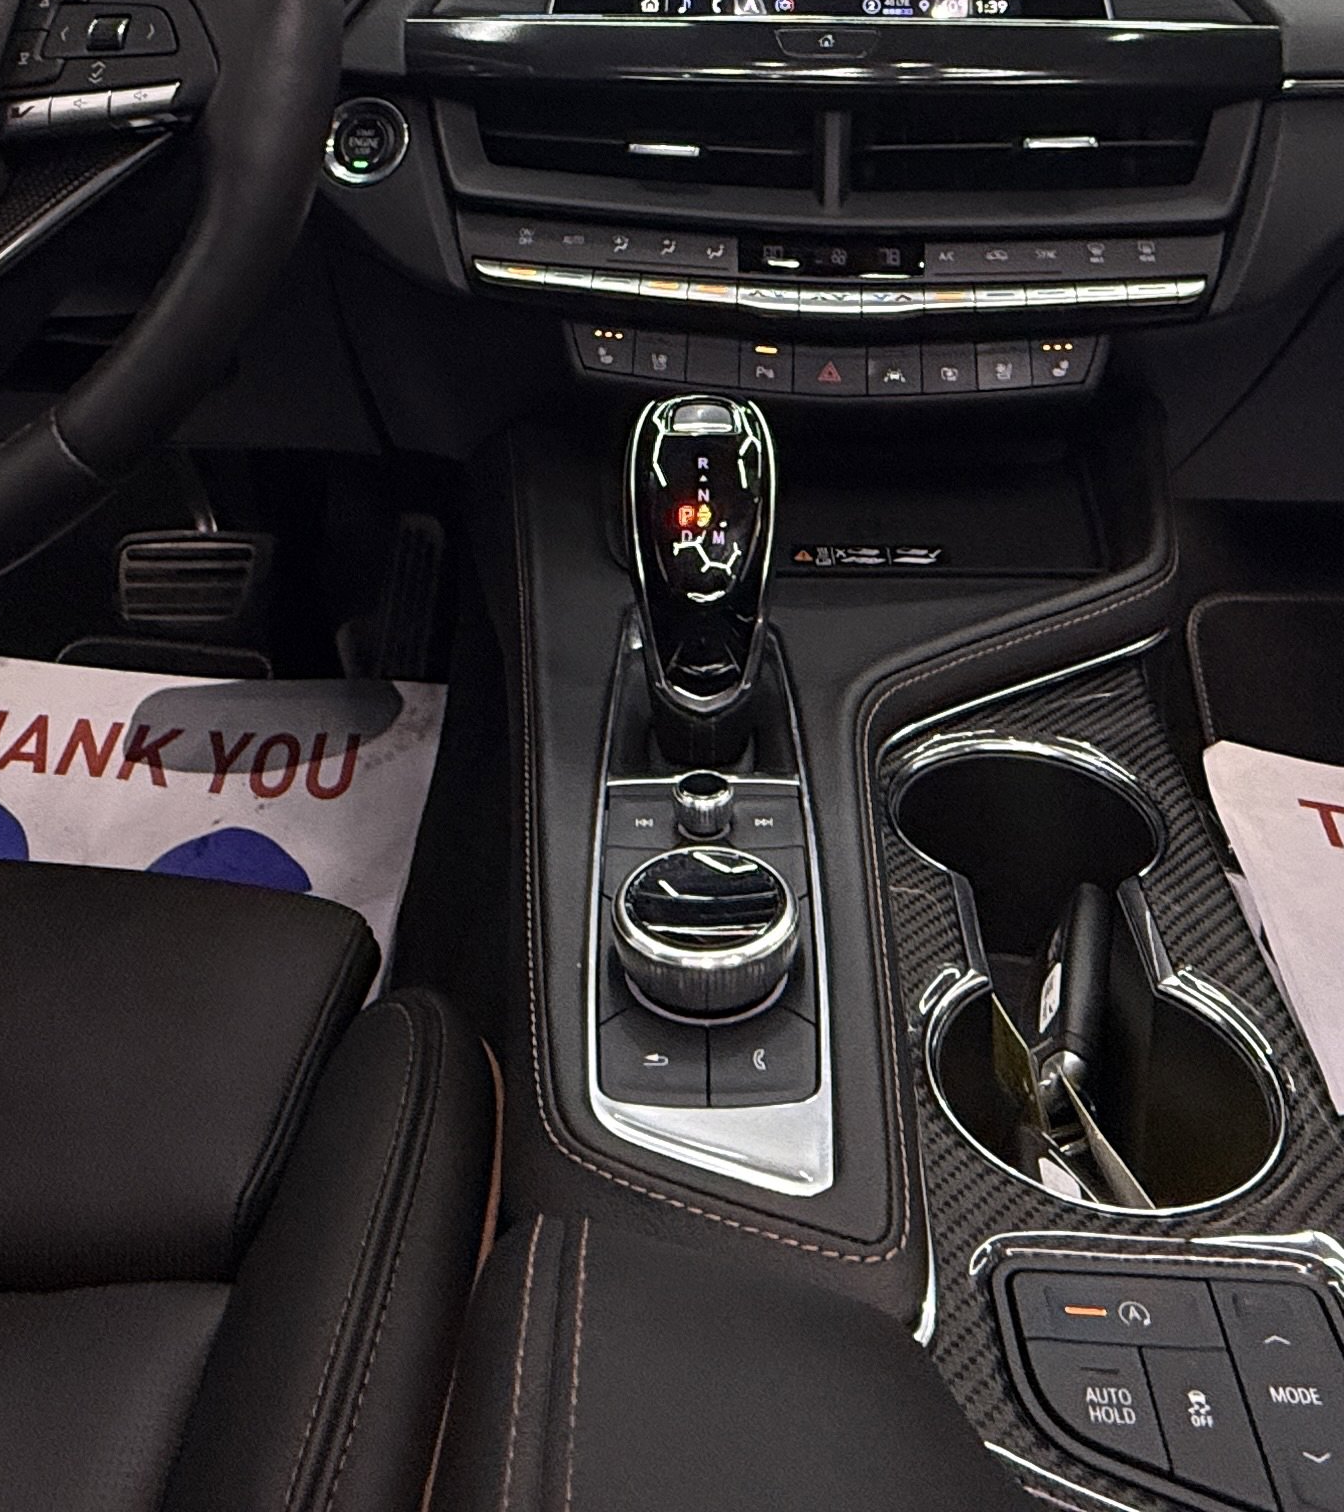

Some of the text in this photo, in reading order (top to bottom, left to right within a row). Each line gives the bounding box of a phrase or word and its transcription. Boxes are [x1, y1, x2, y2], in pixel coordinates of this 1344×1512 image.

[975, 0, 1008, 14] 1:39
[698, 457, 709, 469] R
[697, 488, 710, 502] N
[678, 505, 695, 527] P
[712, 530, 725, 545] M
[207, 730, 361, 801] YOU
[1085, 1386, 1132, 1406] AUTO
[1269, 1386, 1323, 1407] MODE
[1088, 1405, 1137, 1426] HOLD
[1191, 1414, 1215, 1428] OFF
